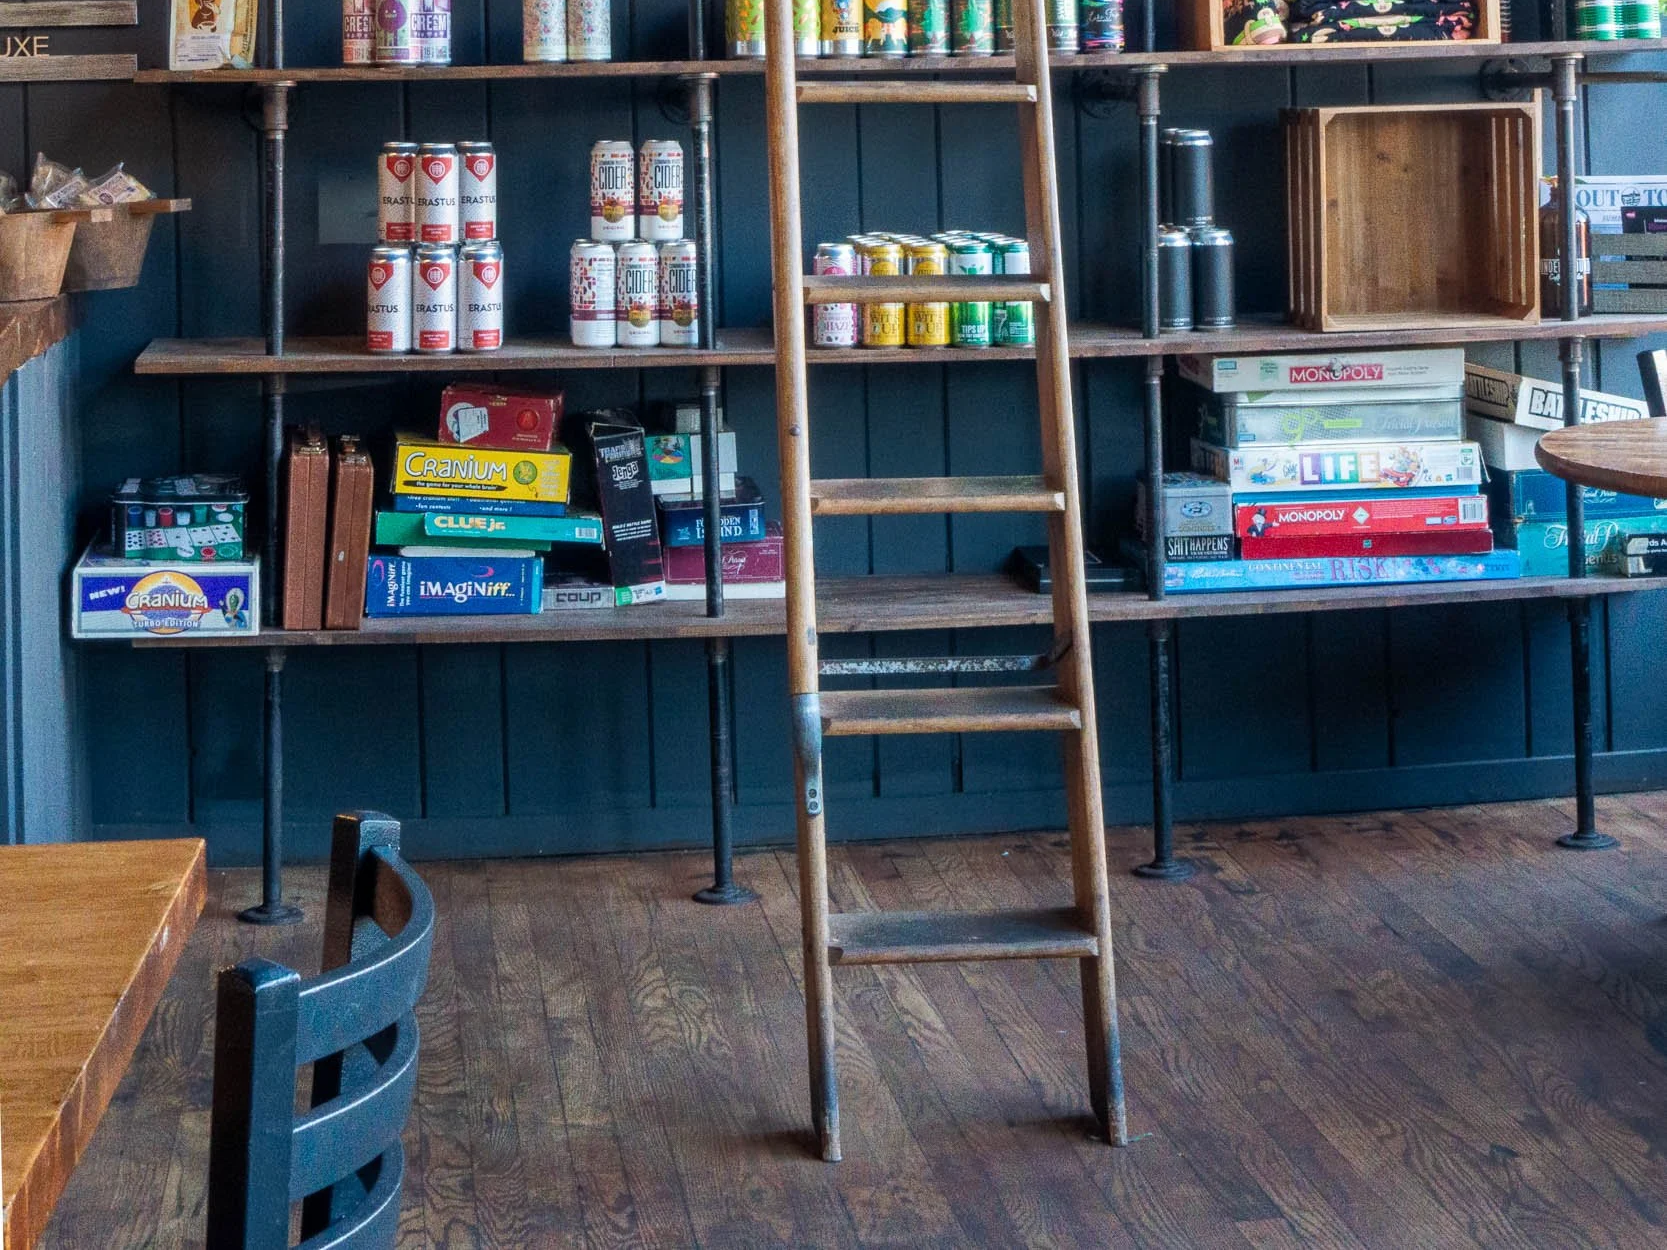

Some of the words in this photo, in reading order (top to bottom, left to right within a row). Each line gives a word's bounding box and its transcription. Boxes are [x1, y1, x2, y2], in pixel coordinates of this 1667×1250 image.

[599, 165, 627, 189] CIDER
[654, 164, 682, 188] CIDER
[418, 197, 456, 206] ERASTUS
[1576, 190, 1620, 207] OUT
[625, 269, 654, 294] CIDER
[416, 303, 454, 312] ERASTUS
[962, 324, 976, 334] TIPS
[1291, 366, 1382, 382] MONOPOLY
[612, 461, 639, 480] Jenga
[1302, 454, 1379, 483] LIFE
[434, 516, 487, 530] CLUE
[1278, 510, 1345, 523] MONOPOLY
[1190, 537, 1229, 551] HAPPENS
[1330, 556, 1389, 581] RISK
[89, 586, 127, 601] NEW!
[133, 620, 161, 628] TURBO
[163, 619, 199, 628] EDITION
